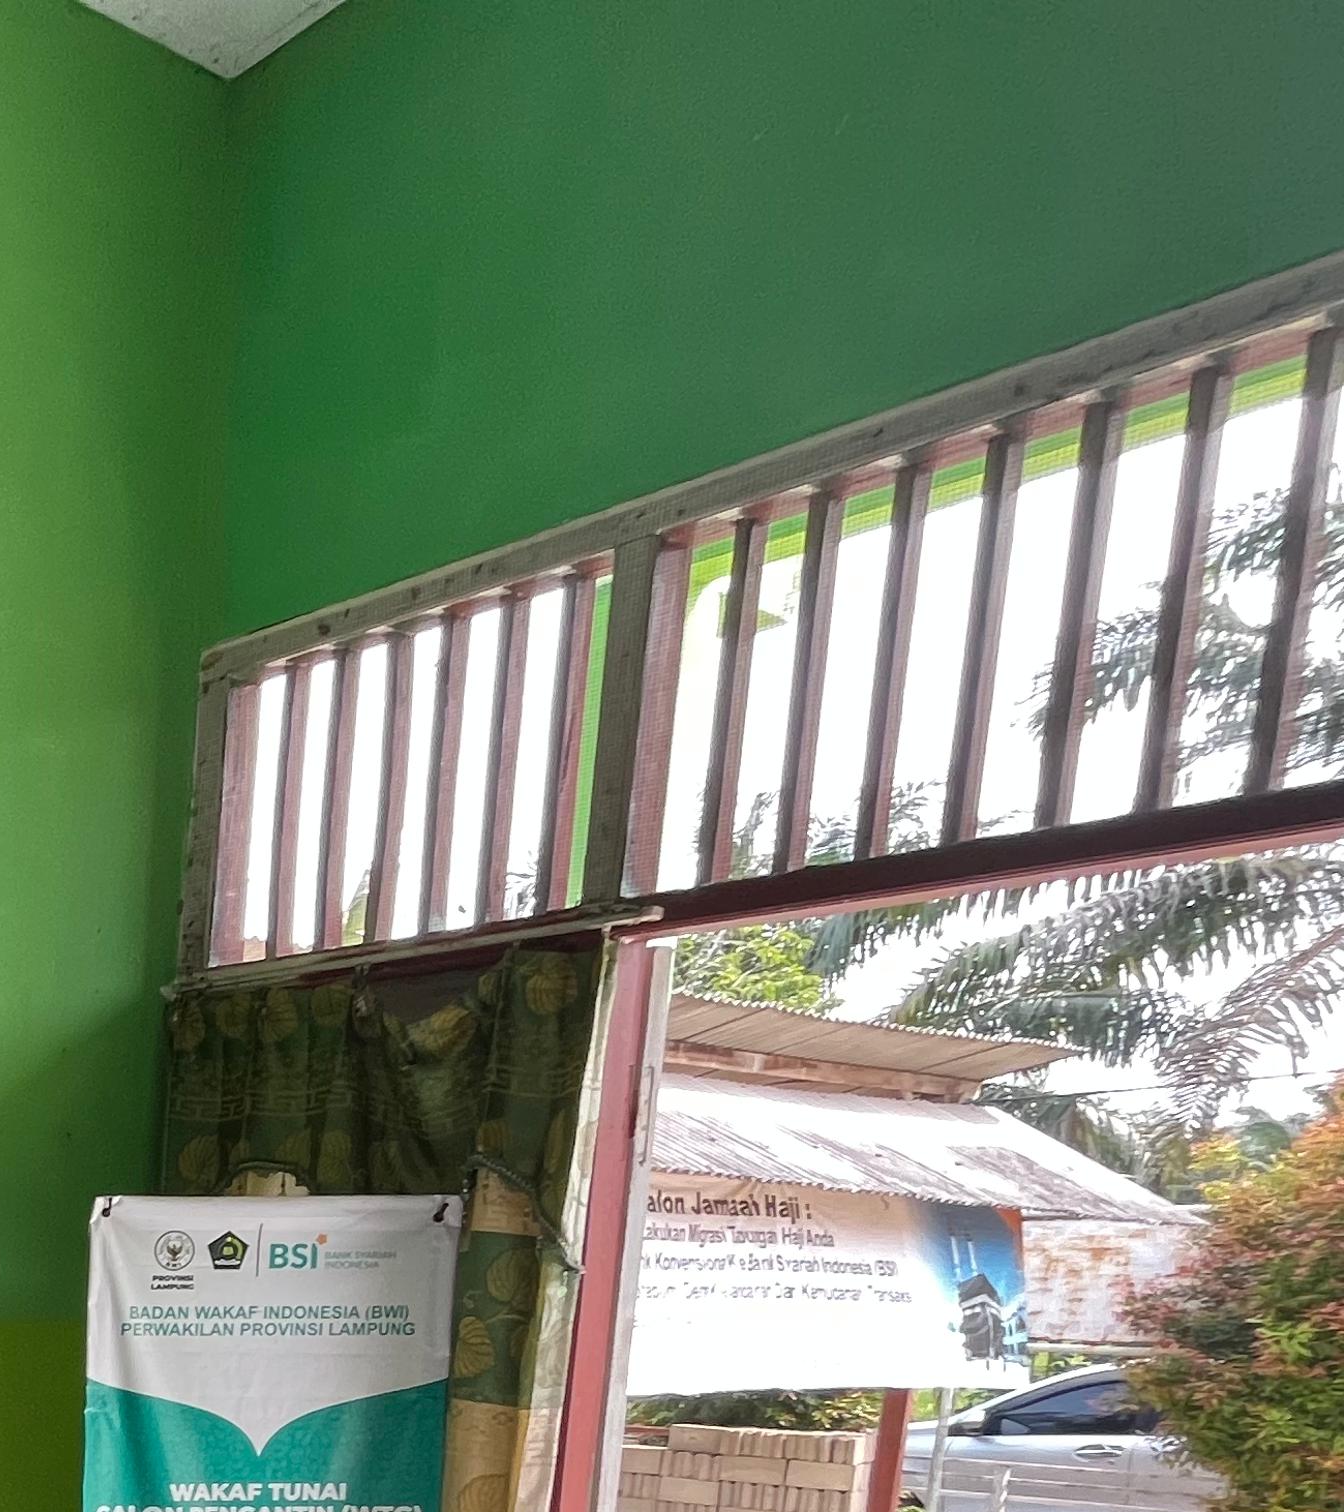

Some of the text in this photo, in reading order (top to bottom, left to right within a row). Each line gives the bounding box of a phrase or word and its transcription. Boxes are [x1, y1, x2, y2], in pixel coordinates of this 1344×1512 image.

[645, 1189, 685, 1216] alon
[764, 1192, 801, 1225] Haji
[268, 1239, 320, 1270] BSI
[130, 1305, 409, 1322] BADAN WAKAF INDONESIA (BWI)
[120, 1322, 416, 1337] PERWAKILAN PROVINSI LAMPUNG
[169, 1482, 347, 1502] WAKAF TUNAI
